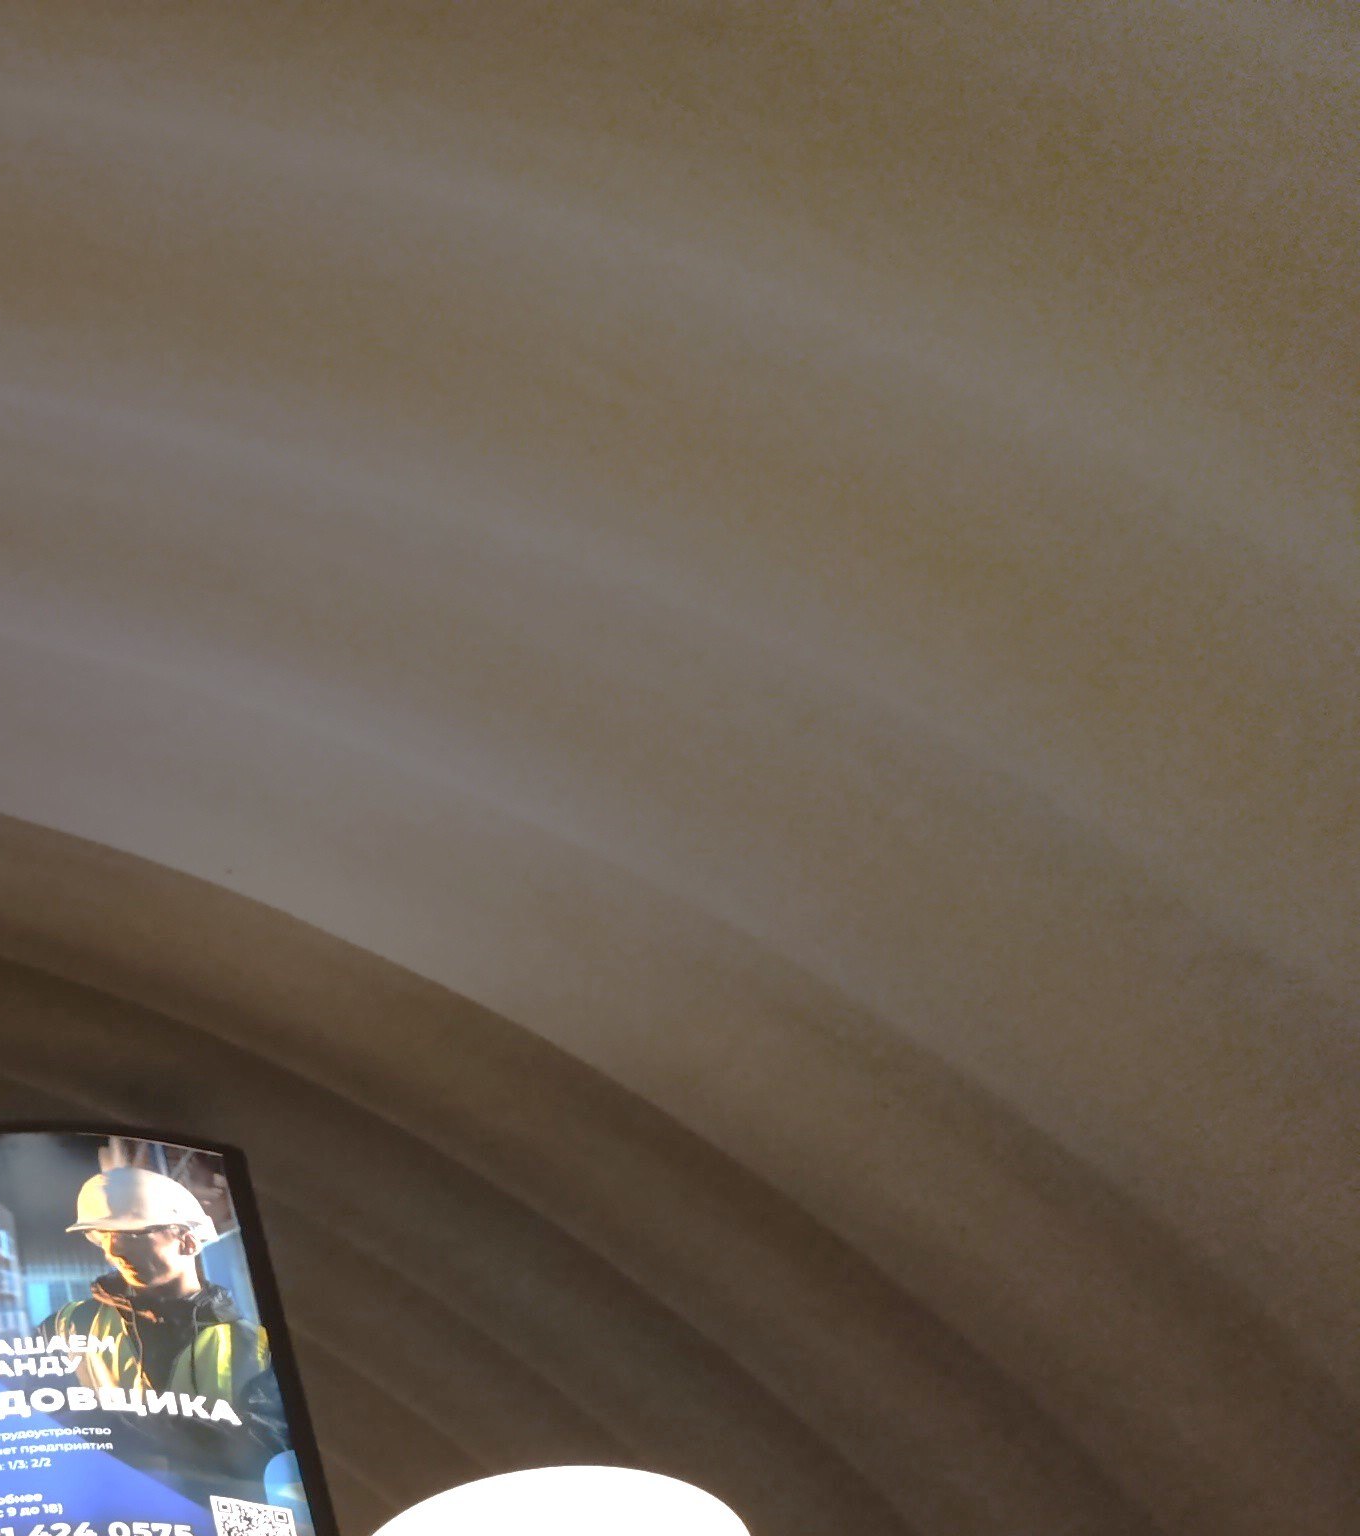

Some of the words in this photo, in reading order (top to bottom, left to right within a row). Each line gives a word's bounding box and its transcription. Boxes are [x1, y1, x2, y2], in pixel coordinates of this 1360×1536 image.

[21, 1441, 114, 1455] предприятия
[32, 1457, 52, 1469] 2/2
[7, 1507, 17, 1516] 9
[20, 1507, 40, 1518] до
